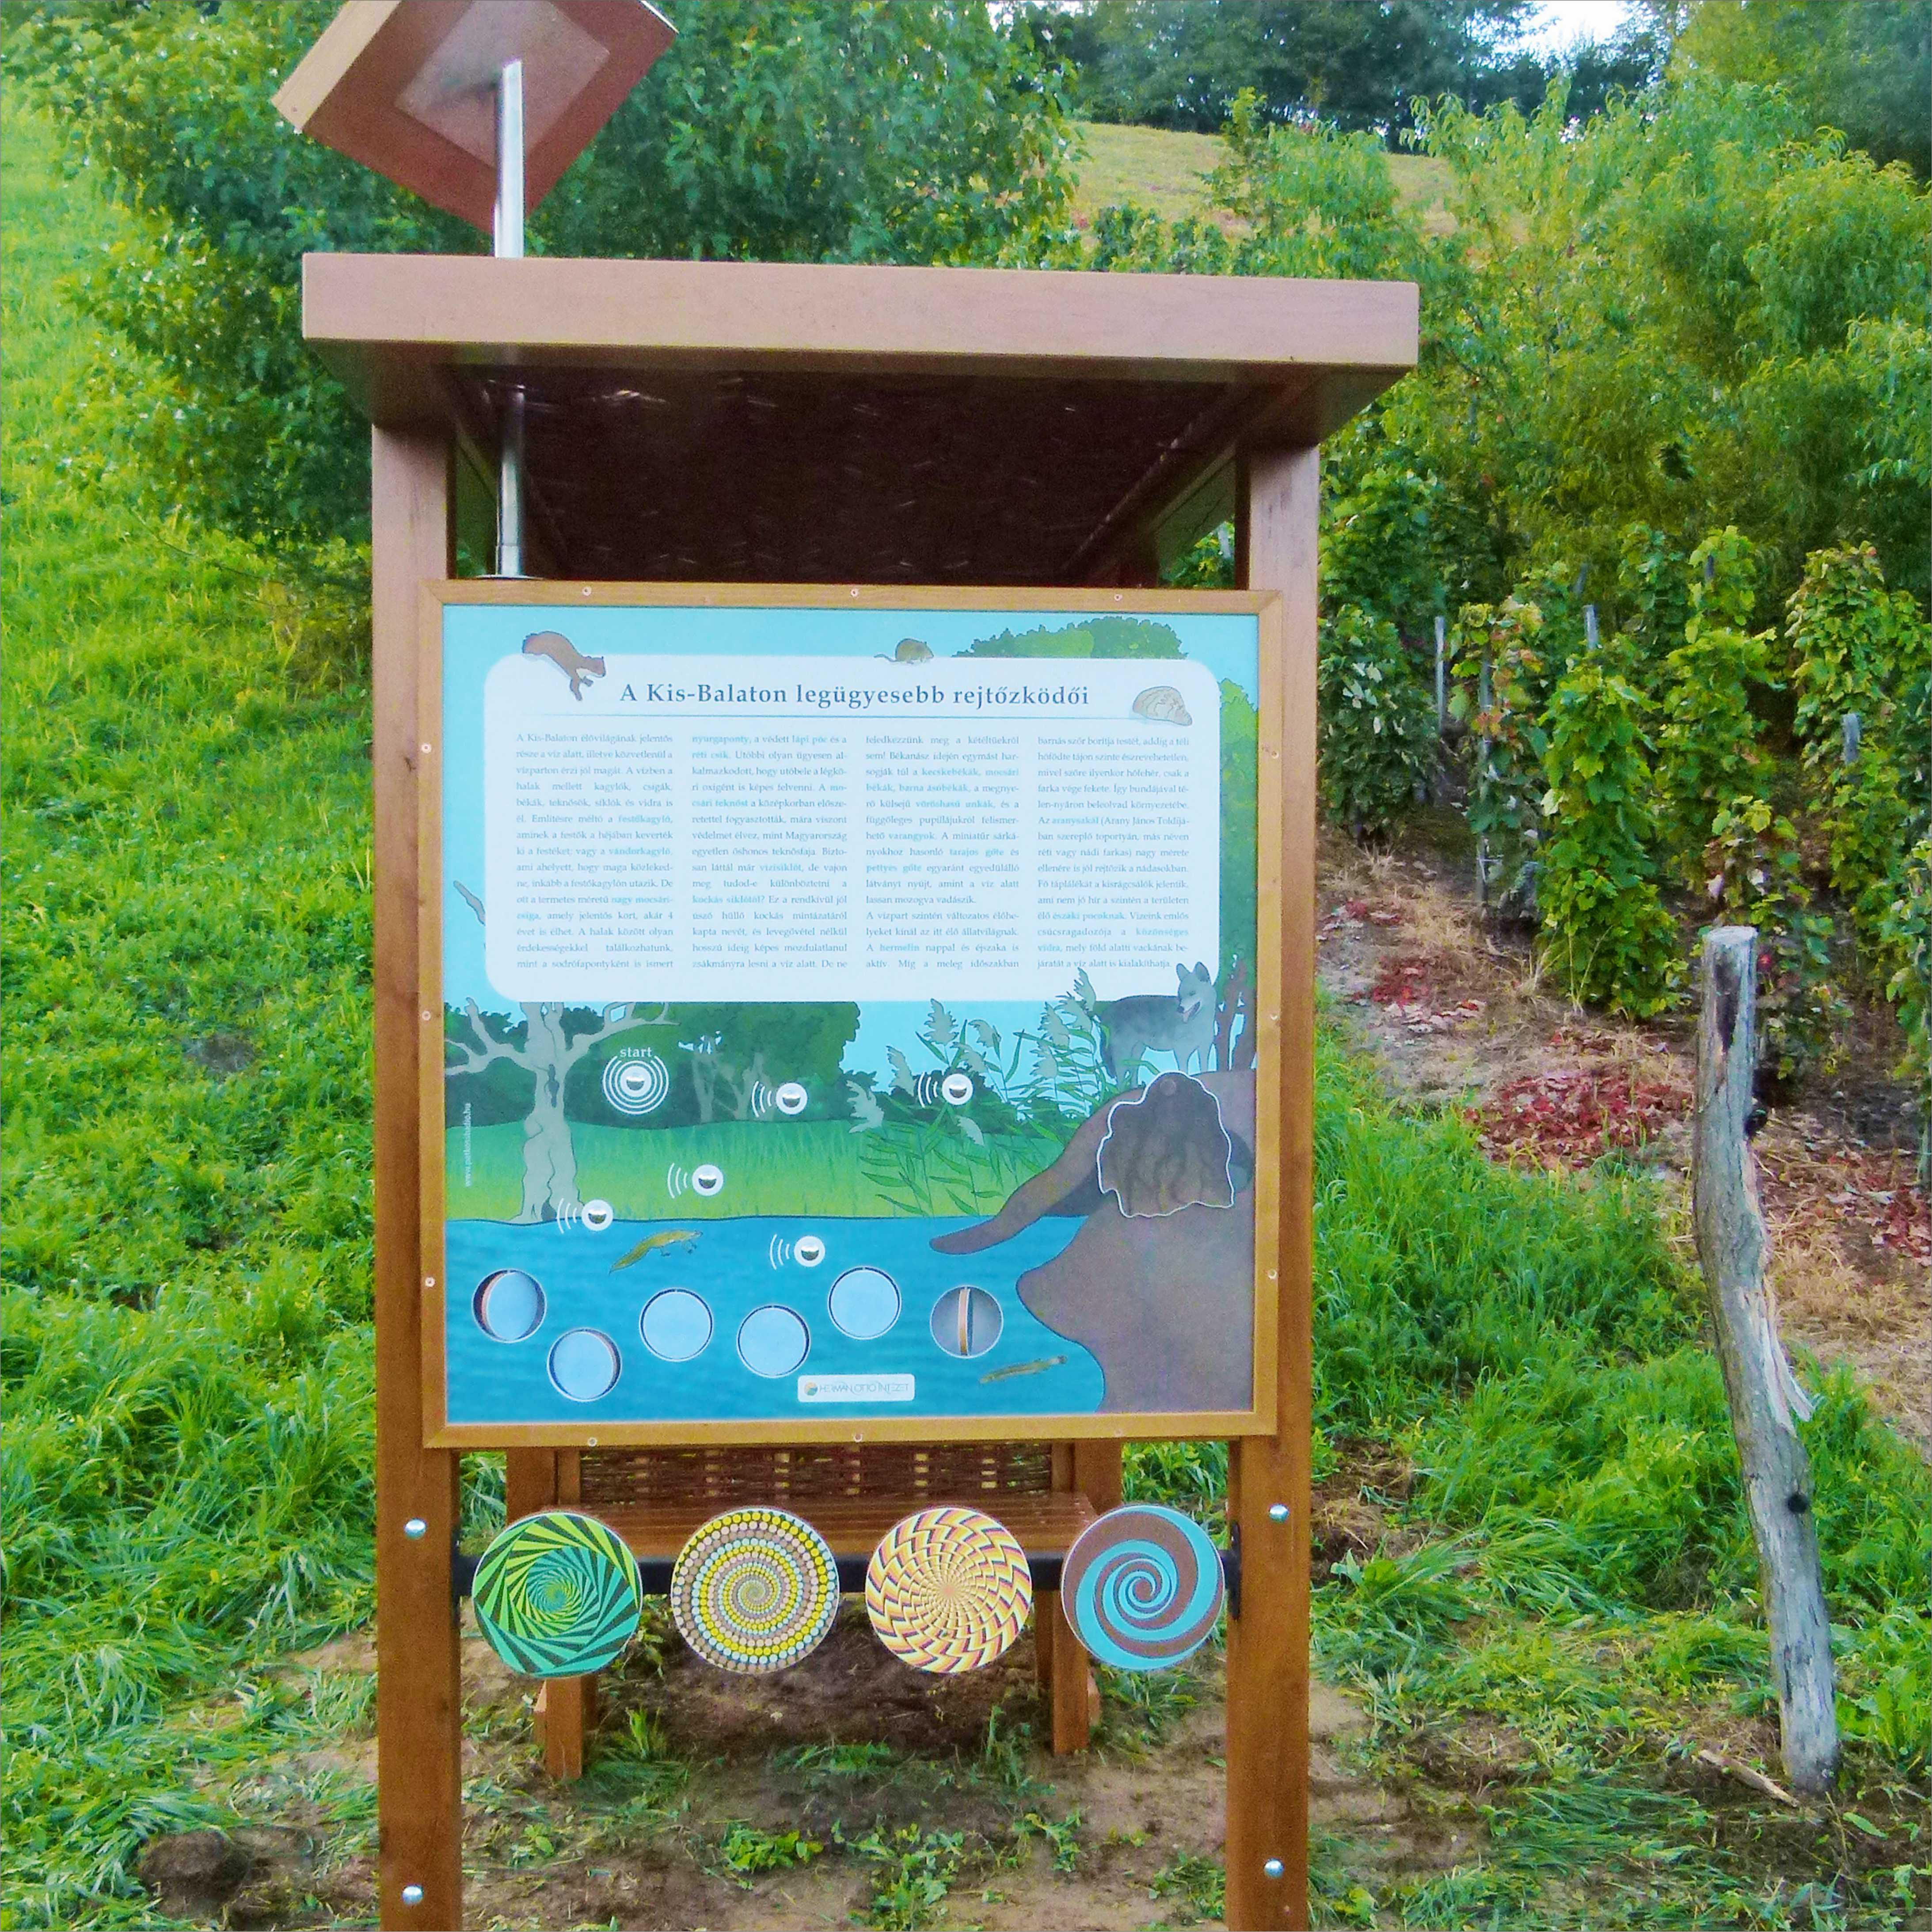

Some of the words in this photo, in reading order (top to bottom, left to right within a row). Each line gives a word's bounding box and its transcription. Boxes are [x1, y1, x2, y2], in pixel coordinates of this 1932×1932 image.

[619, 684, 638, 702] A
[647, 683, 787, 703] Kis-Balaton
[796, 684, 945, 709] legügyesebb
[953, 685, 1089, 710] rejtőzködői
[620, 1047, 652, 1057] start
